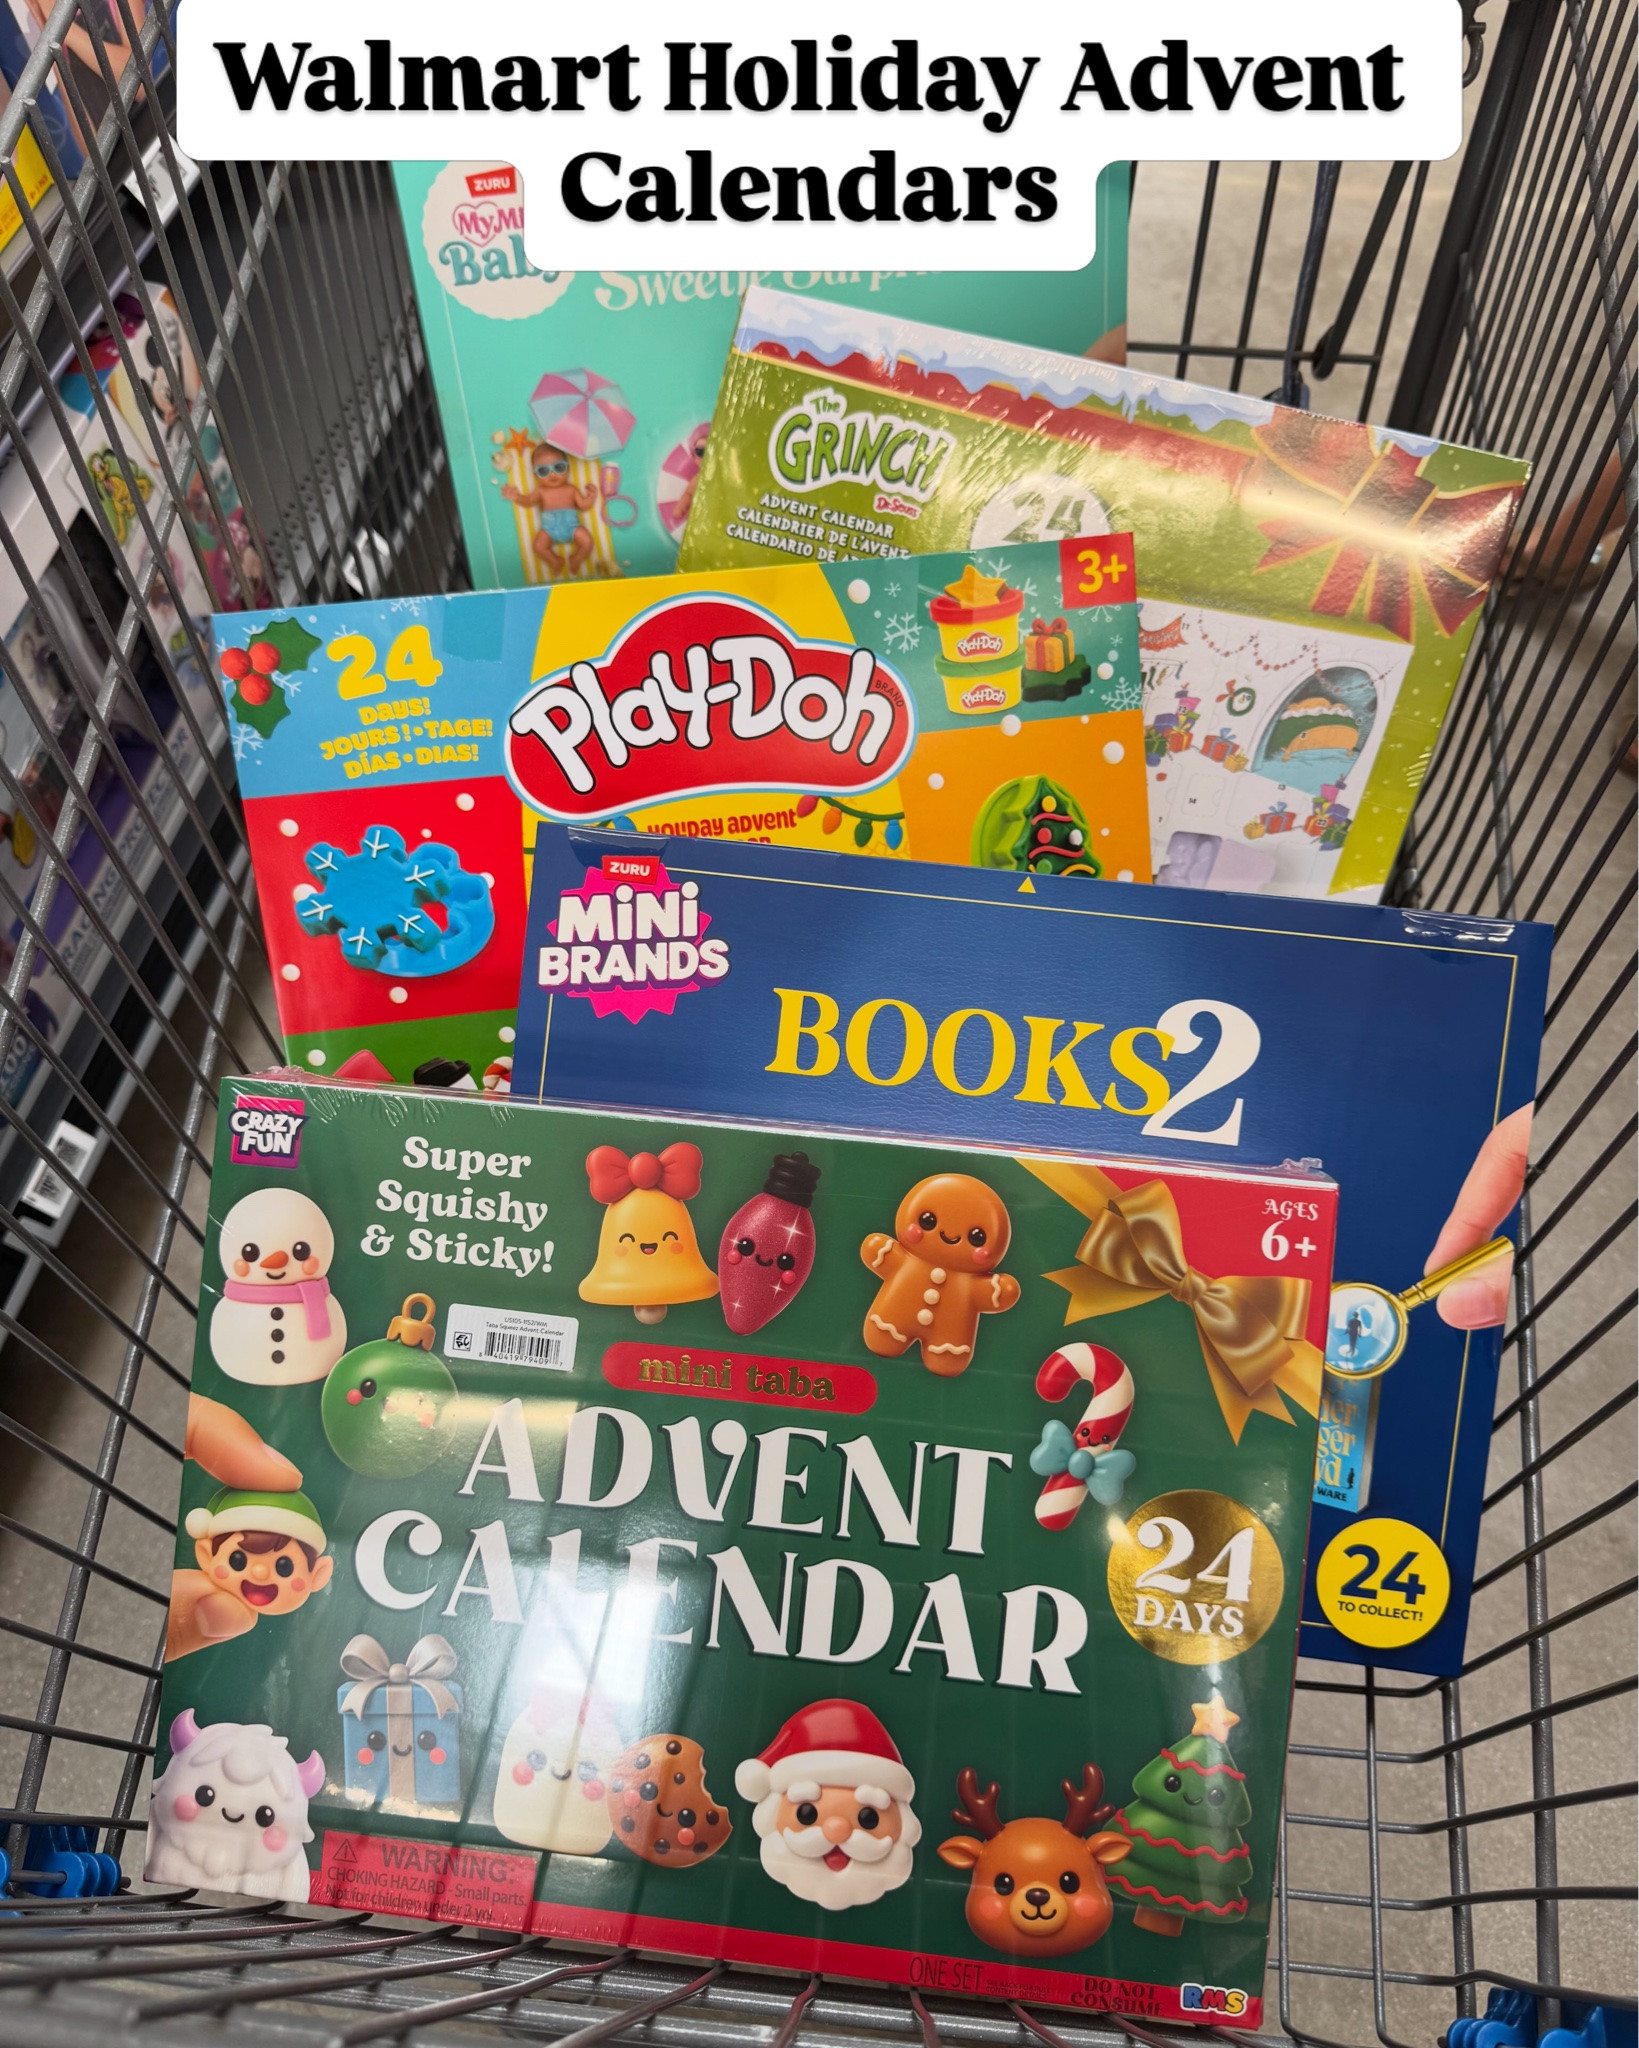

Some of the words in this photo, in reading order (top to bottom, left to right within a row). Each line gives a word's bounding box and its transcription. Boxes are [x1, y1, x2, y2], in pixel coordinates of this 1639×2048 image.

[473, 176, 510, 192] ZURU
[809, 397, 841, 415] The
[775, 413, 949, 493] GRINCH
[738, 507, 825, 541] CALENDRIER
[828, 530, 847, 547] DE
[760, 493, 819, 519] ADVENT
[821, 509, 894, 539] CALENDAR
[1003, 492, 1085, 543] 24
[726, 523, 813, 557] CALENDARIO
[817, 546, 836, 563] DE
[1077, 550, 1127, 593] 3+
[327, 624, 443, 700] 24
[957, 634, 1003, 651] Play-Doh
[509, 634, 896, 795] Play-Doh
[874, 680, 905, 709] BRAND
[961, 686, 1006, 704] Play-Doh
[415, 744, 479, 765] DIAS!
[609, 861, 650, 877] ZURU
[538, 939, 730, 986] BRANDS
[765, 987, 1176, 1117] BOOKS
[1141, 999, 1261, 1147] 2
[231, 1110, 303, 1135] CRAZY
[241, 1131, 293, 1154] FUN
[402, 1136, 531, 1180] Super
[376, 1179, 548, 1233] Squishy
[1261, 1199, 1318, 1221] AGES
[360, 1224, 394, 1257] &
[406, 1227, 555, 1278] Sticky!
[1261, 1220, 1317, 1261] 6+
[540, 1328, 564, 1336] Calendar
[494, 1352, 519, 1362] 40419
[523, 1355, 549, 1365] 79409
[639, 1354, 732, 1390] mini
[746, 1365, 836, 1401] taba
[457, 1397, 1013, 1557] ADVENT
[1317, 1485, 1347, 1502] WARE
[1135, 1516, 1255, 1602] 24
[1340, 1544, 1426, 1606] 24
[352, 1509, 1090, 1695] CALENDAR
[1133, 1594, 1245, 1638] DAYS
[1337, 1600, 1356, 1612] TO
[1358, 1603, 1424, 1622] COLLECT!
[381, 1842, 515, 1884] WARNING:
[326, 1884, 349, 1900] Not
[350, 1885, 369, 1902] for
[371, 1890, 422, 1912] children
[424, 1899, 463, 1917] under
[464, 1904, 472, 1917] 3
[327, 1866, 387, 1887] CHOKING
[391, 1876, 445, 1895] HAZARD
[455, 1883, 489, 1901] Small
[492, 1891, 527, 1907] parts.
[909, 1956, 948, 1987] ONE
[951, 1963, 984, 1991] SET
[1084, 1977, 1111, 1993] DO
[1118, 1981, 1156, 2000] NOT
[1183, 1985, 1245, 2014] RMS
